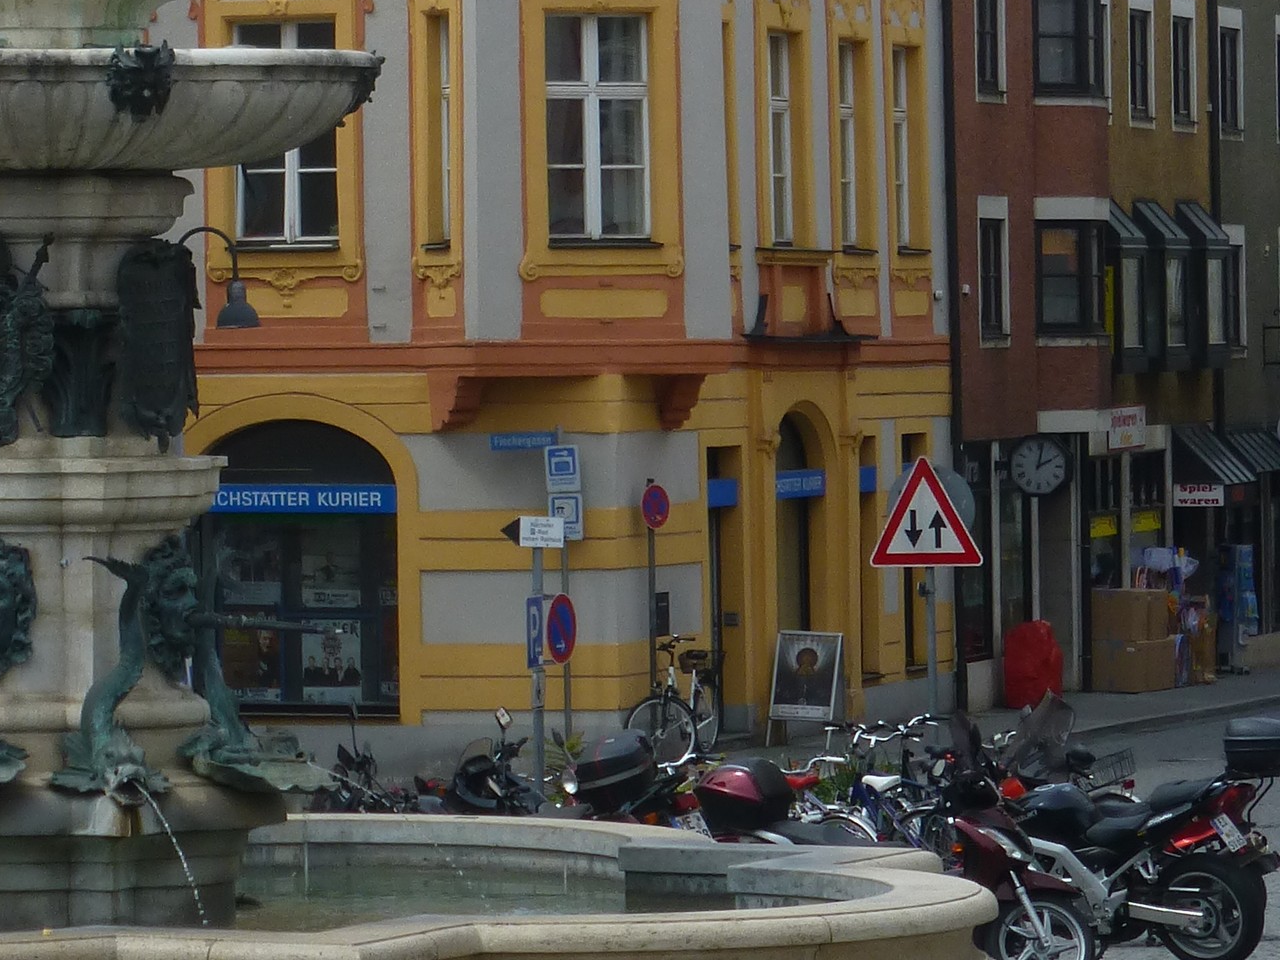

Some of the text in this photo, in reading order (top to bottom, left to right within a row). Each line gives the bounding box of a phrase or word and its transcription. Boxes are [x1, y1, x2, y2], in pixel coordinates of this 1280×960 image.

[1179, 483, 1218, 494] Spiel-
[212, 491, 382, 507] ICHSTÄTTER KURIER
[1178, 497, 1220, 505] waren
[530, 605, 540, 660] P
